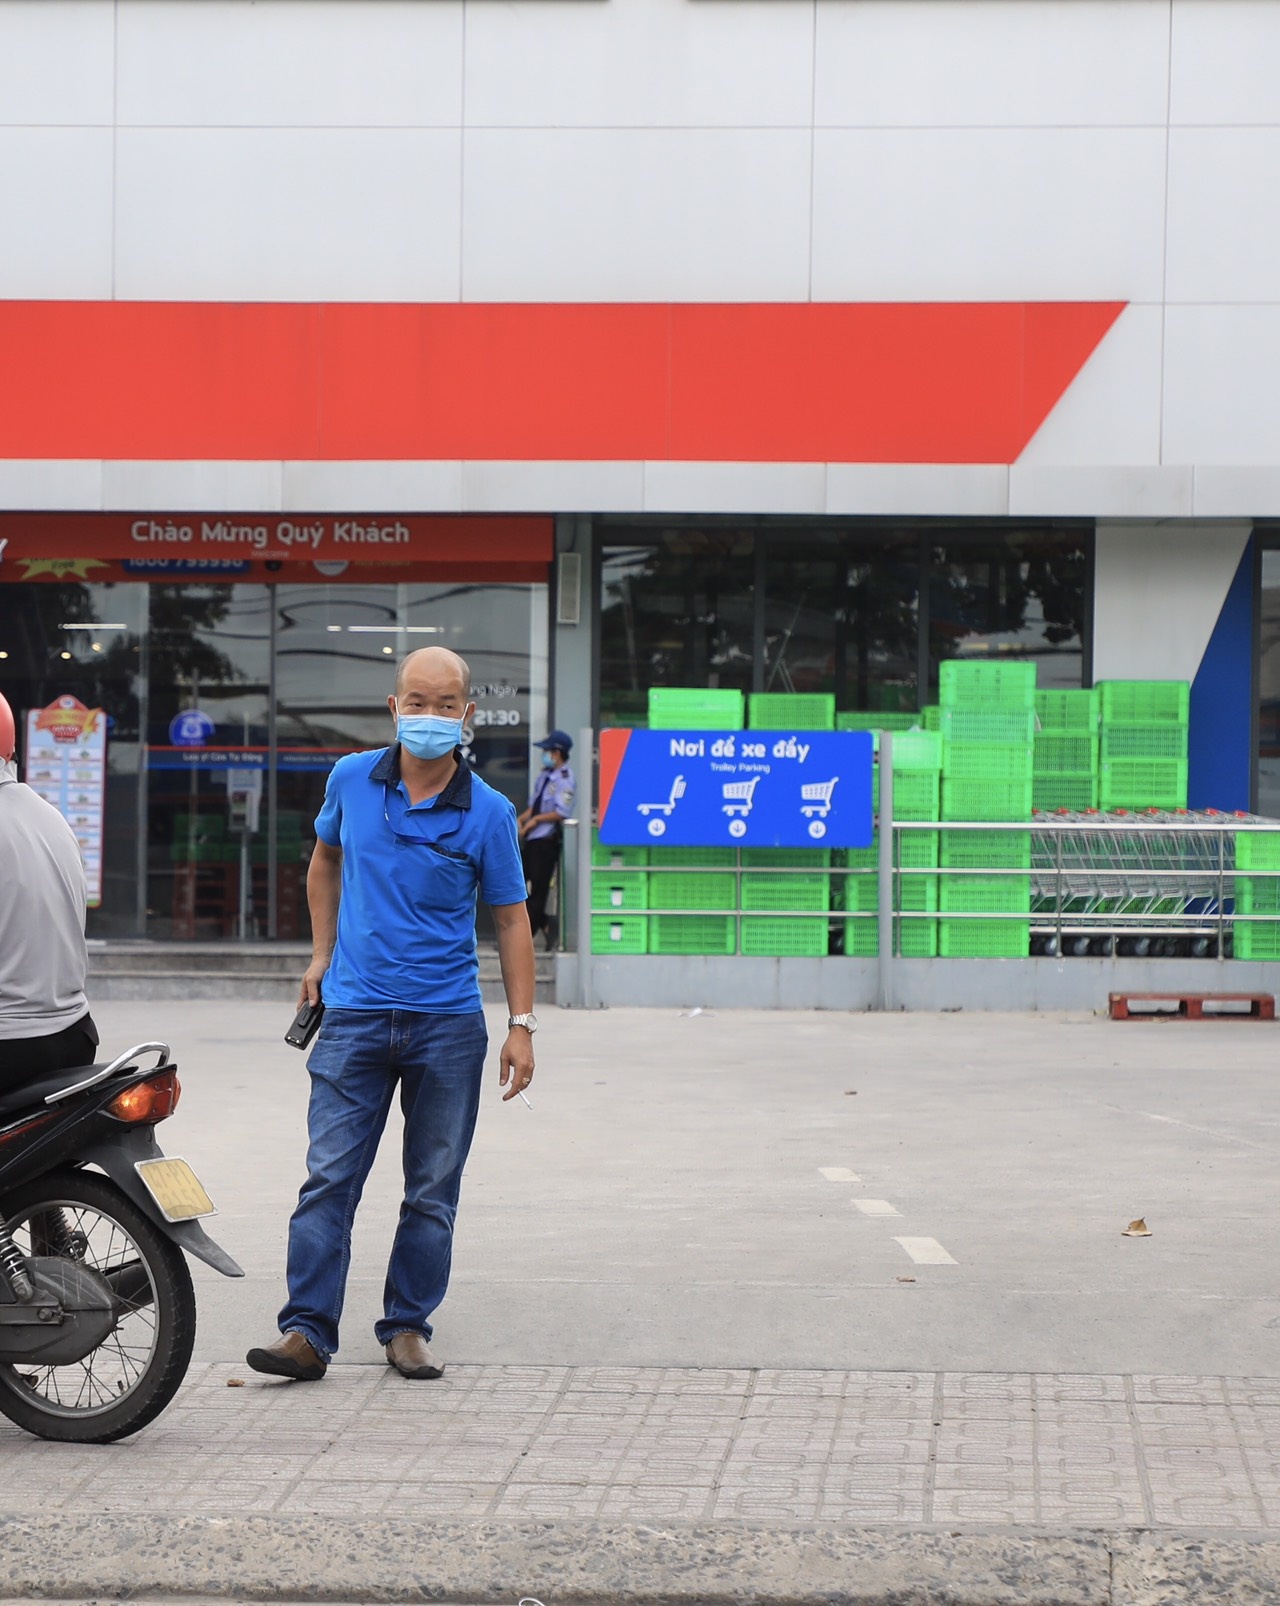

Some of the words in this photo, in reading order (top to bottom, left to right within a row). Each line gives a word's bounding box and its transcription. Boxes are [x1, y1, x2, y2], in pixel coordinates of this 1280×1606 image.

[131, 520, 193, 542] Chào
[201, 519, 269, 549] Mừng
[276, 520, 324, 548] Quý
[333, 520, 410, 543] Khách
[670, 738, 705, 757] Nơi
[710, 735, 736, 758] để
[741, 743, 766, 758] xe
[772, 735, 810, 764] đẩy
[710, 762, 737, 773] Trolley
[739, 763, 771, 774] Parking
